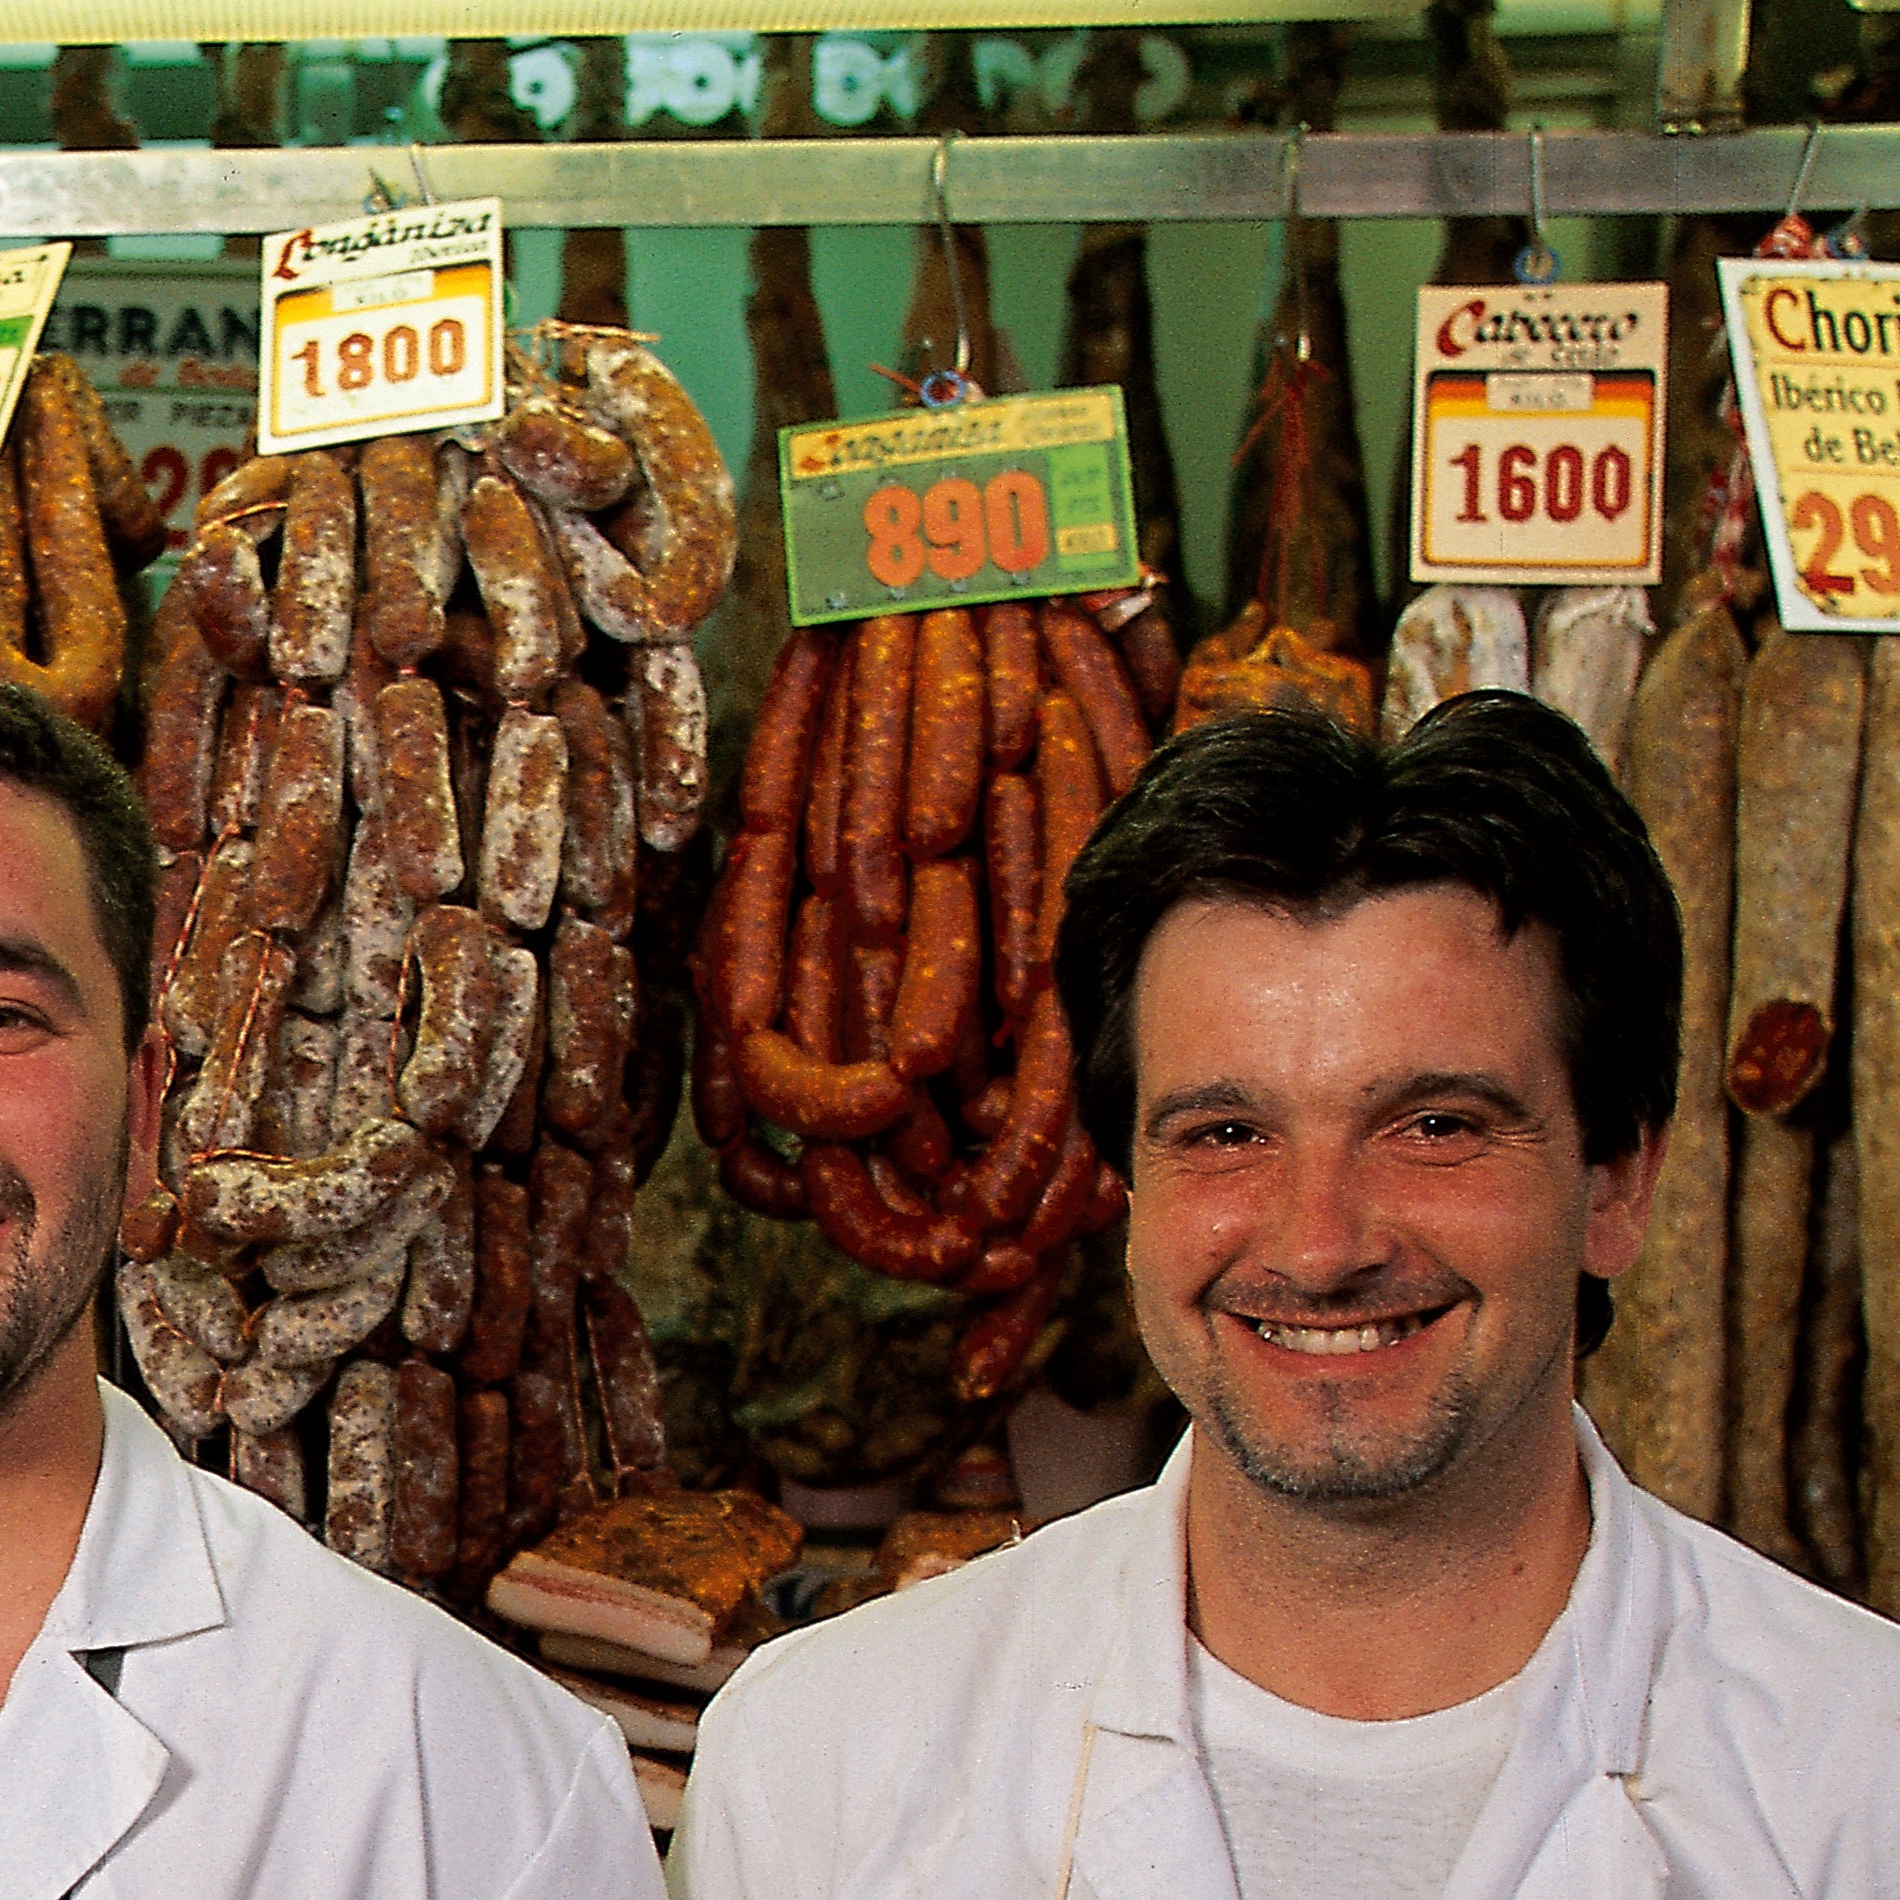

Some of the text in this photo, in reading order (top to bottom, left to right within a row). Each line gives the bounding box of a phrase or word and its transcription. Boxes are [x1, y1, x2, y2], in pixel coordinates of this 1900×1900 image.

[291, 318, 466, 398] 1800
[1448, 444, 1631, 523] 1600
[1804, 426, 1900, 466] de Be
[863, 469, 1049, 588] 890
